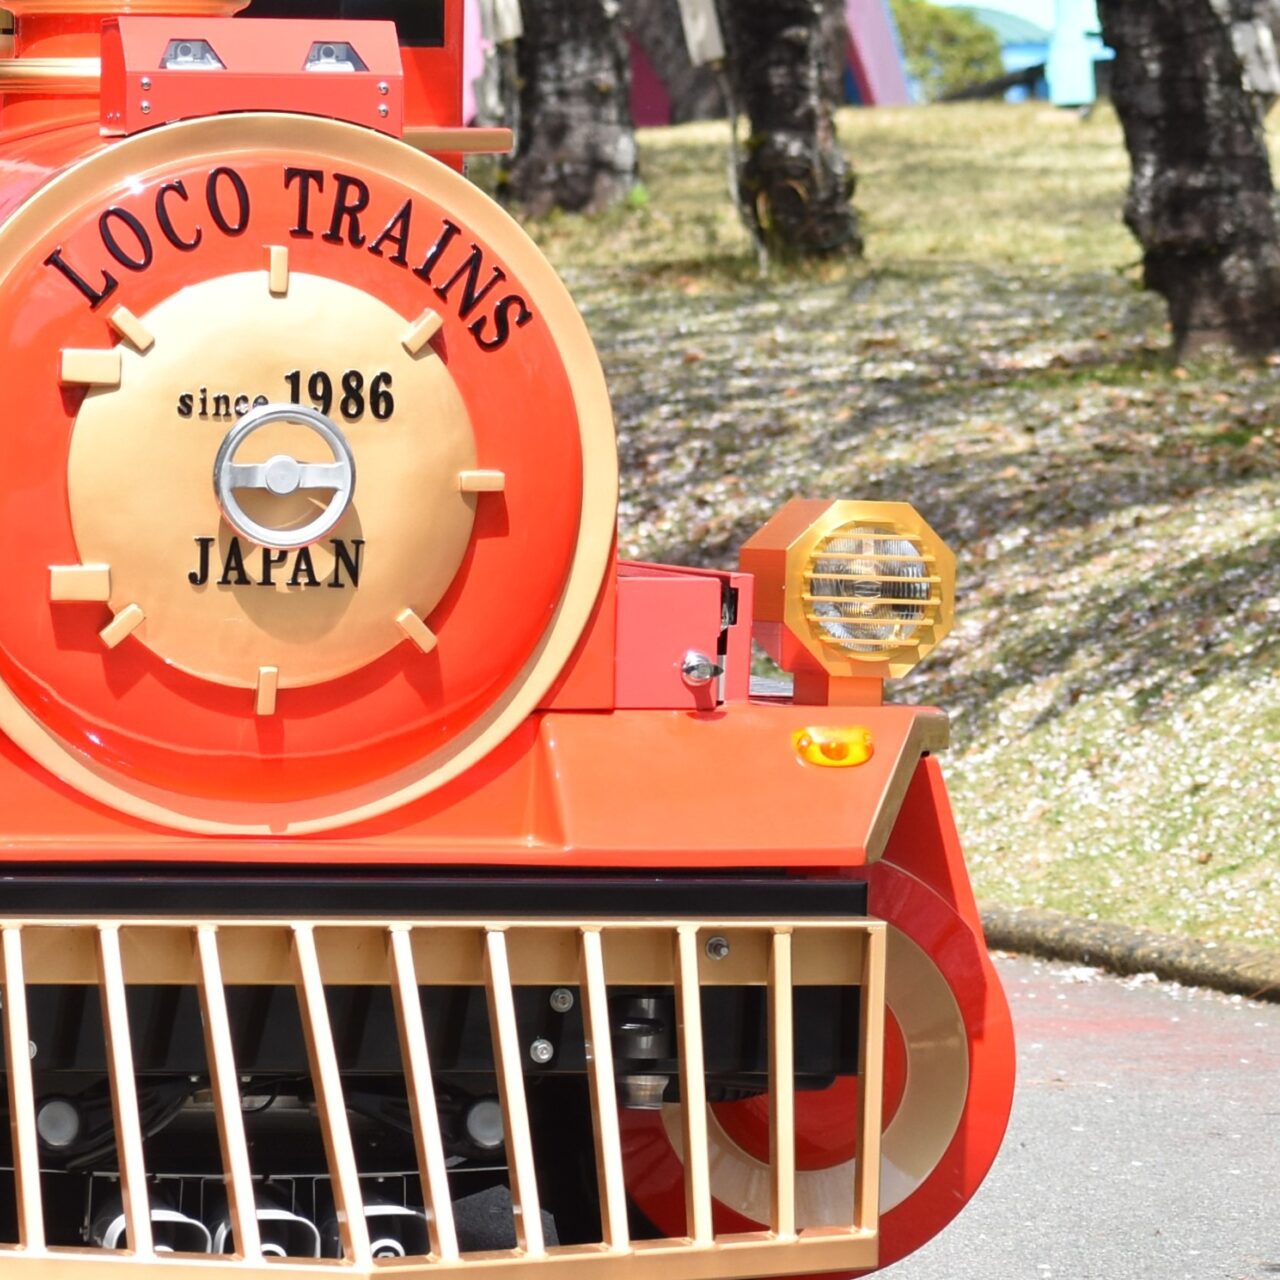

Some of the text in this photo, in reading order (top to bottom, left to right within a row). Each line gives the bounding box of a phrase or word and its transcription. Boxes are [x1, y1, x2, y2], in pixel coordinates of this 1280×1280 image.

[44, 166, 532, 350] LOCO TRAINS
[284, 370, 395, 420] 1986
[188, 537, 365, 588] JAPAN
